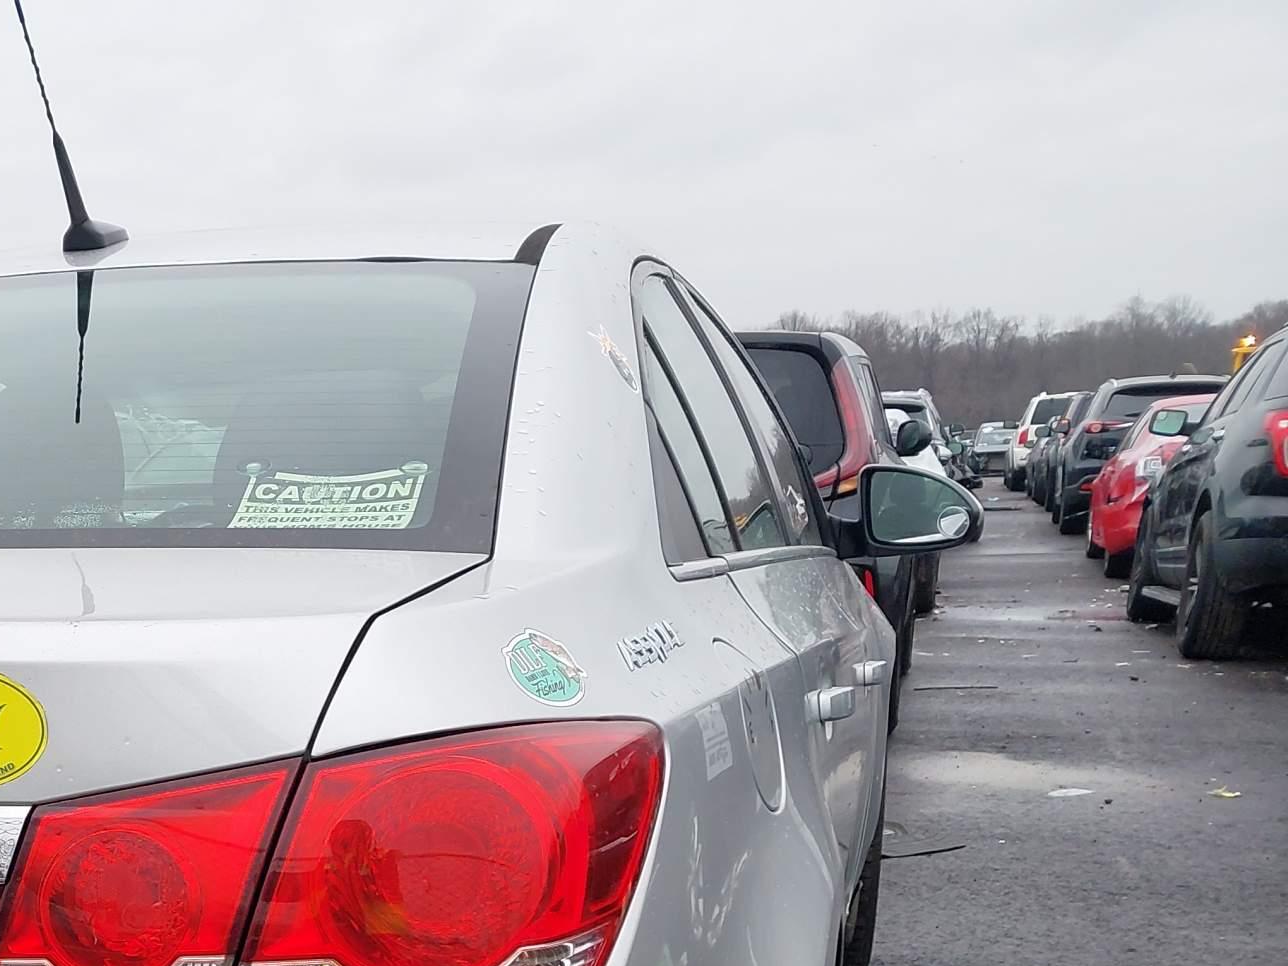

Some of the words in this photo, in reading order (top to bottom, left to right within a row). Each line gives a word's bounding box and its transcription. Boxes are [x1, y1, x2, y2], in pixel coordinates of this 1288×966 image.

[255, 479, 413, 502] CAUTION
[243, 504, 280, 514] THIS
[284, 505, 350, 514] VEHICLE
[355, 502, 410, 513] MAKES
[327, 514, 380, 523] STOPS
[384, 513, 407, 522] AT
